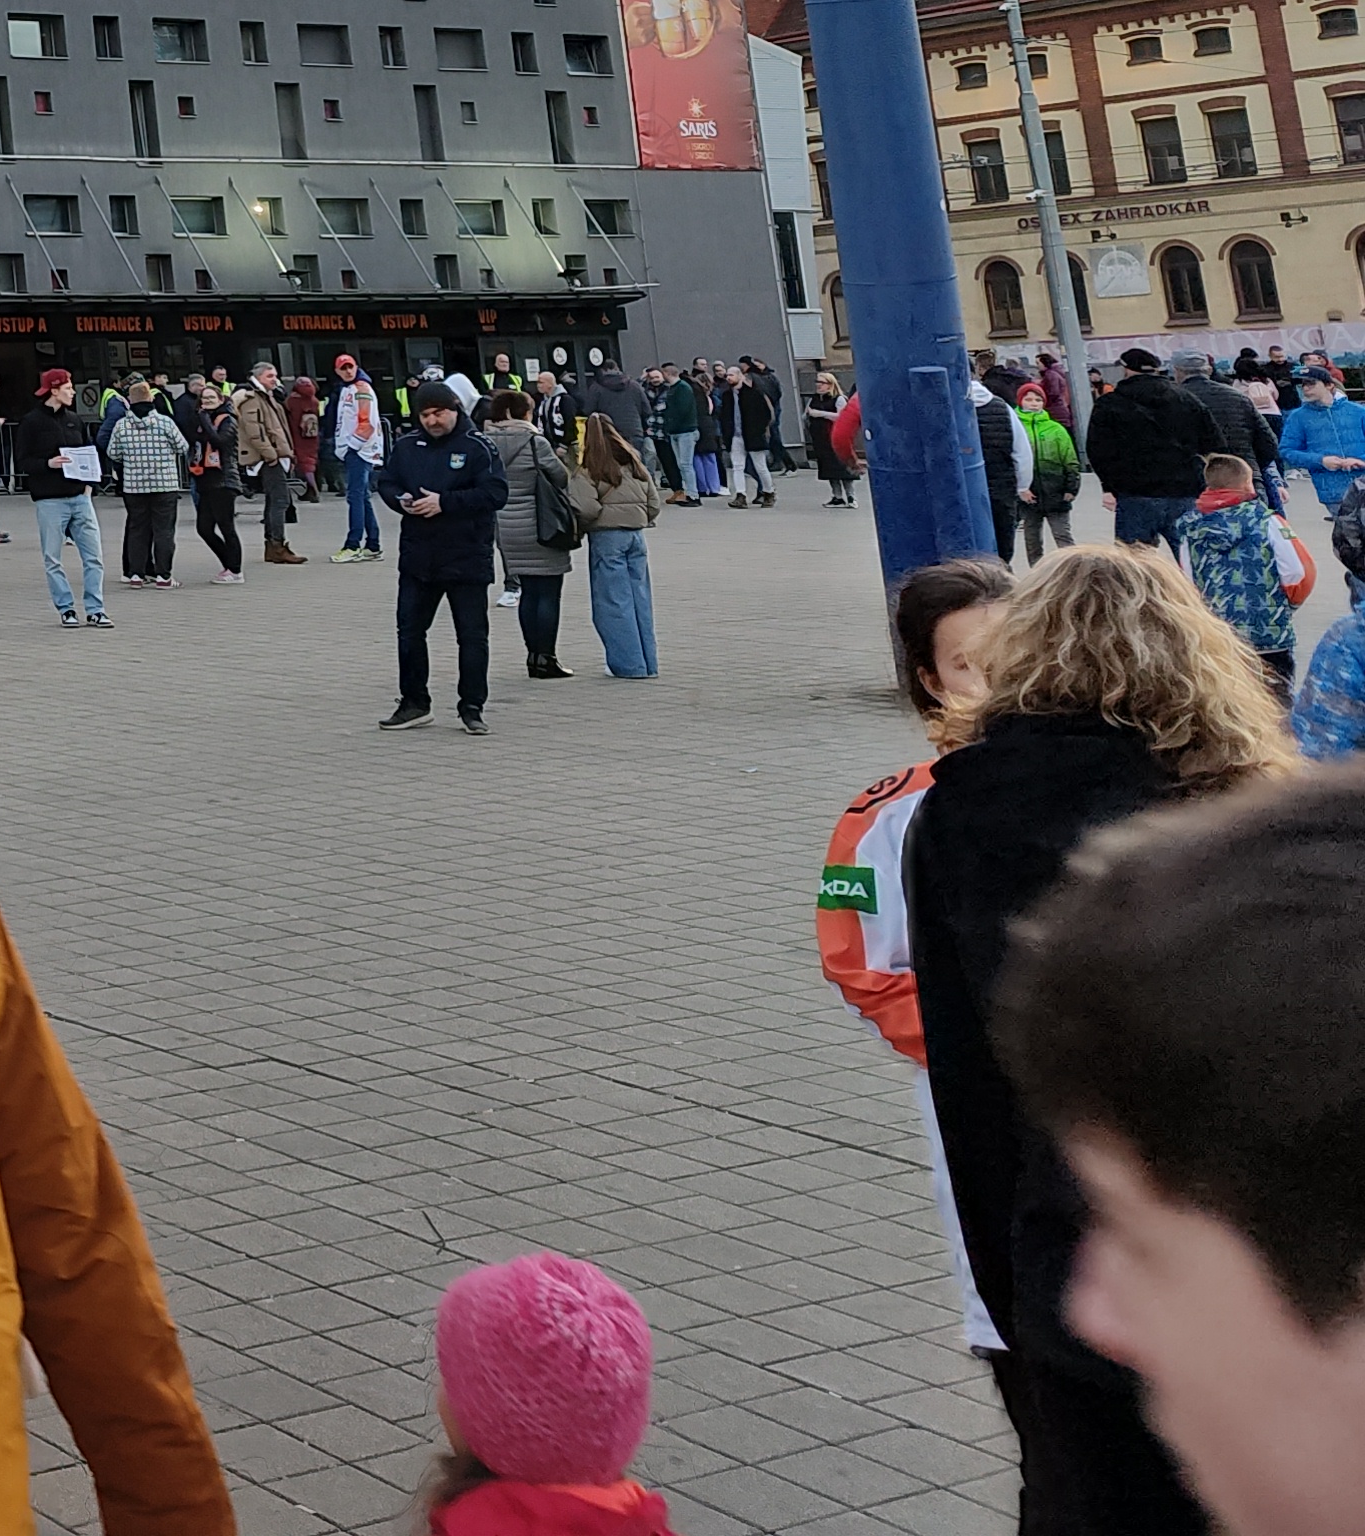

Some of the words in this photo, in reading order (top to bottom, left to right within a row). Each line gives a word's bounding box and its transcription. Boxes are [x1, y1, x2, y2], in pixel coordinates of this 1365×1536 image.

[1017, 214, 1083, 231] OSEX
[183, 316, 221, 331] VSTUP
[224, 316, 234, 331] A
[282, 314, 345, 330] ENTRANCE
[347, 314, 356, 330] A
[380, 314, 416, 330] VSTUP
[420, 313, 429, 329] A
[478, 308, 498, 324] VIP
[38, 317, 48, 333] A
[76, 316, 143, 333] ENTRANCE
[145, 316, 154, 333] A
